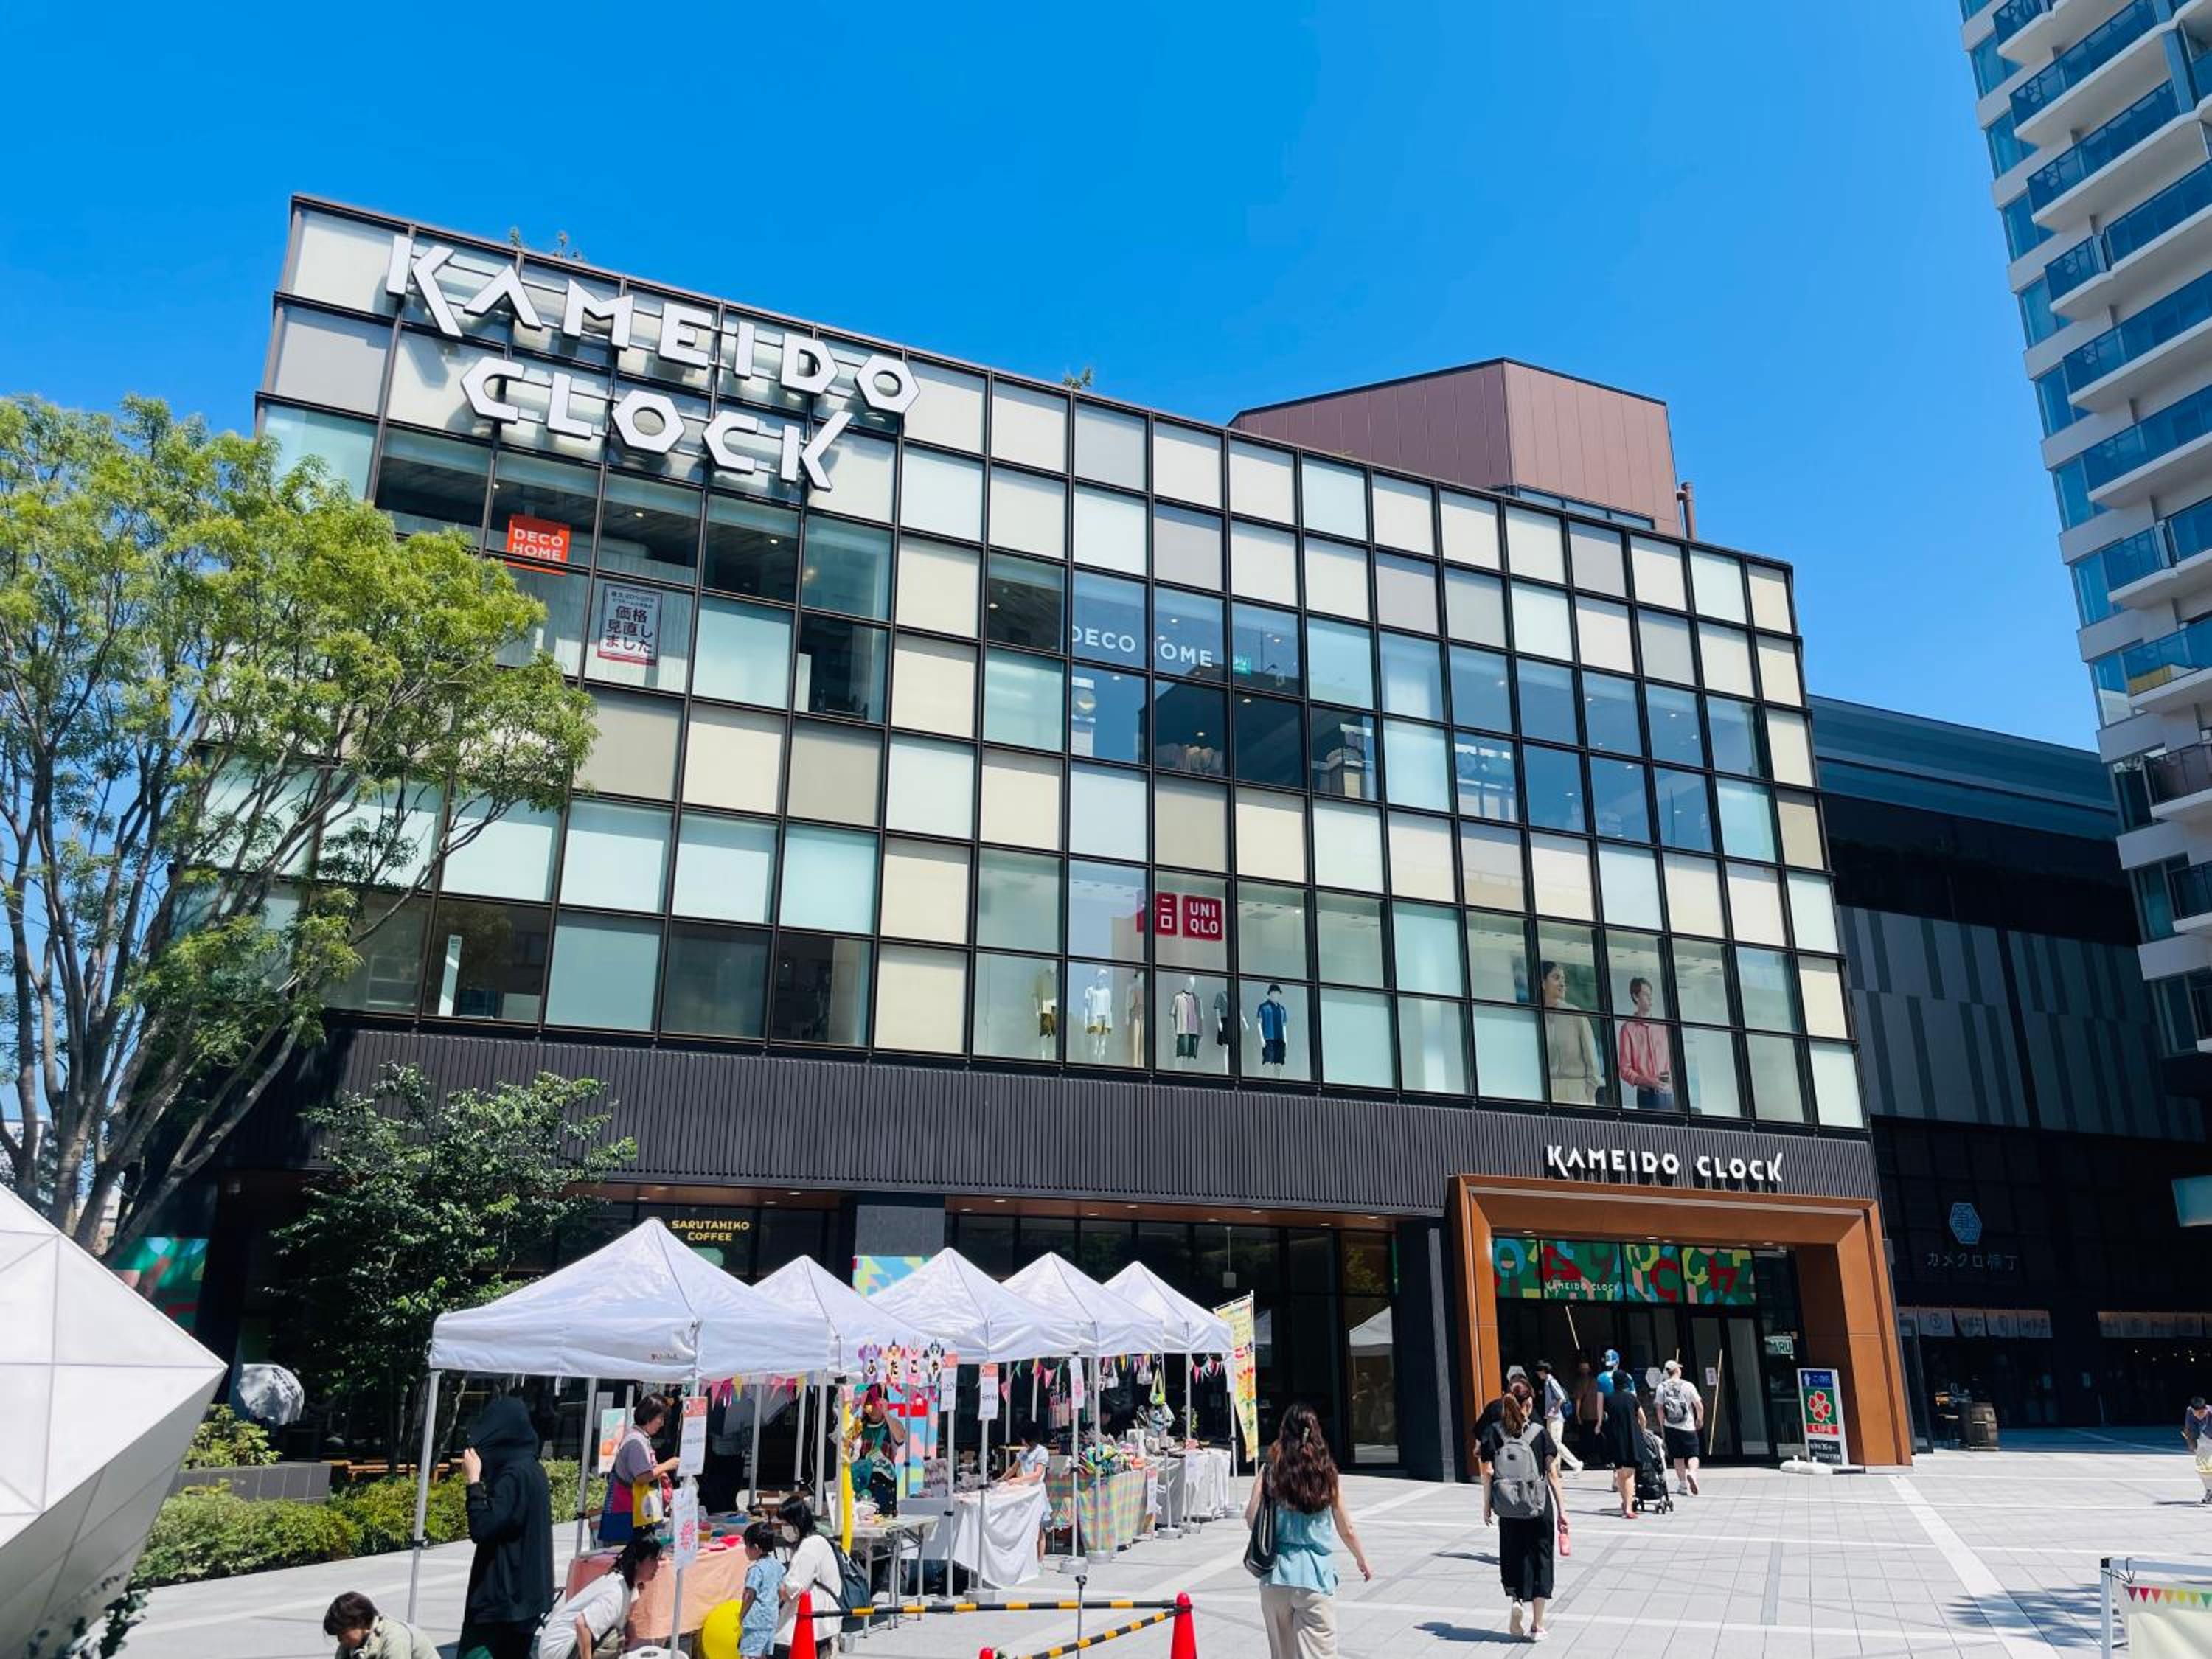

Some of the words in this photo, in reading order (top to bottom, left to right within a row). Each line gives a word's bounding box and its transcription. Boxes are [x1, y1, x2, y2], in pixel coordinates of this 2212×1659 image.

[386, 234, 920, 414] KAMEIDO
[460, 355, 853, 492] CLOCK
[514, 529, 563, 548] DECO
[512, 543, 562, 562] HOME
[616, 605, 647, 623] 価格
[606, 619, 653, 638] 見直し
[606, 635, 653, 654] ました
[1155, 640, 1213, 667] OME
[1189, 902, 1217, 918] UNI
[1189, 919, 1219, 934] QLO
[1546, 1145, 1680, 1178] KAMEIDO
[1696, 1153, 1783, 1181] CLOCK
[672, 1220, 750, 1231] SARUTAHIKO
[687, 1231, 732, 1241] COFFEE
